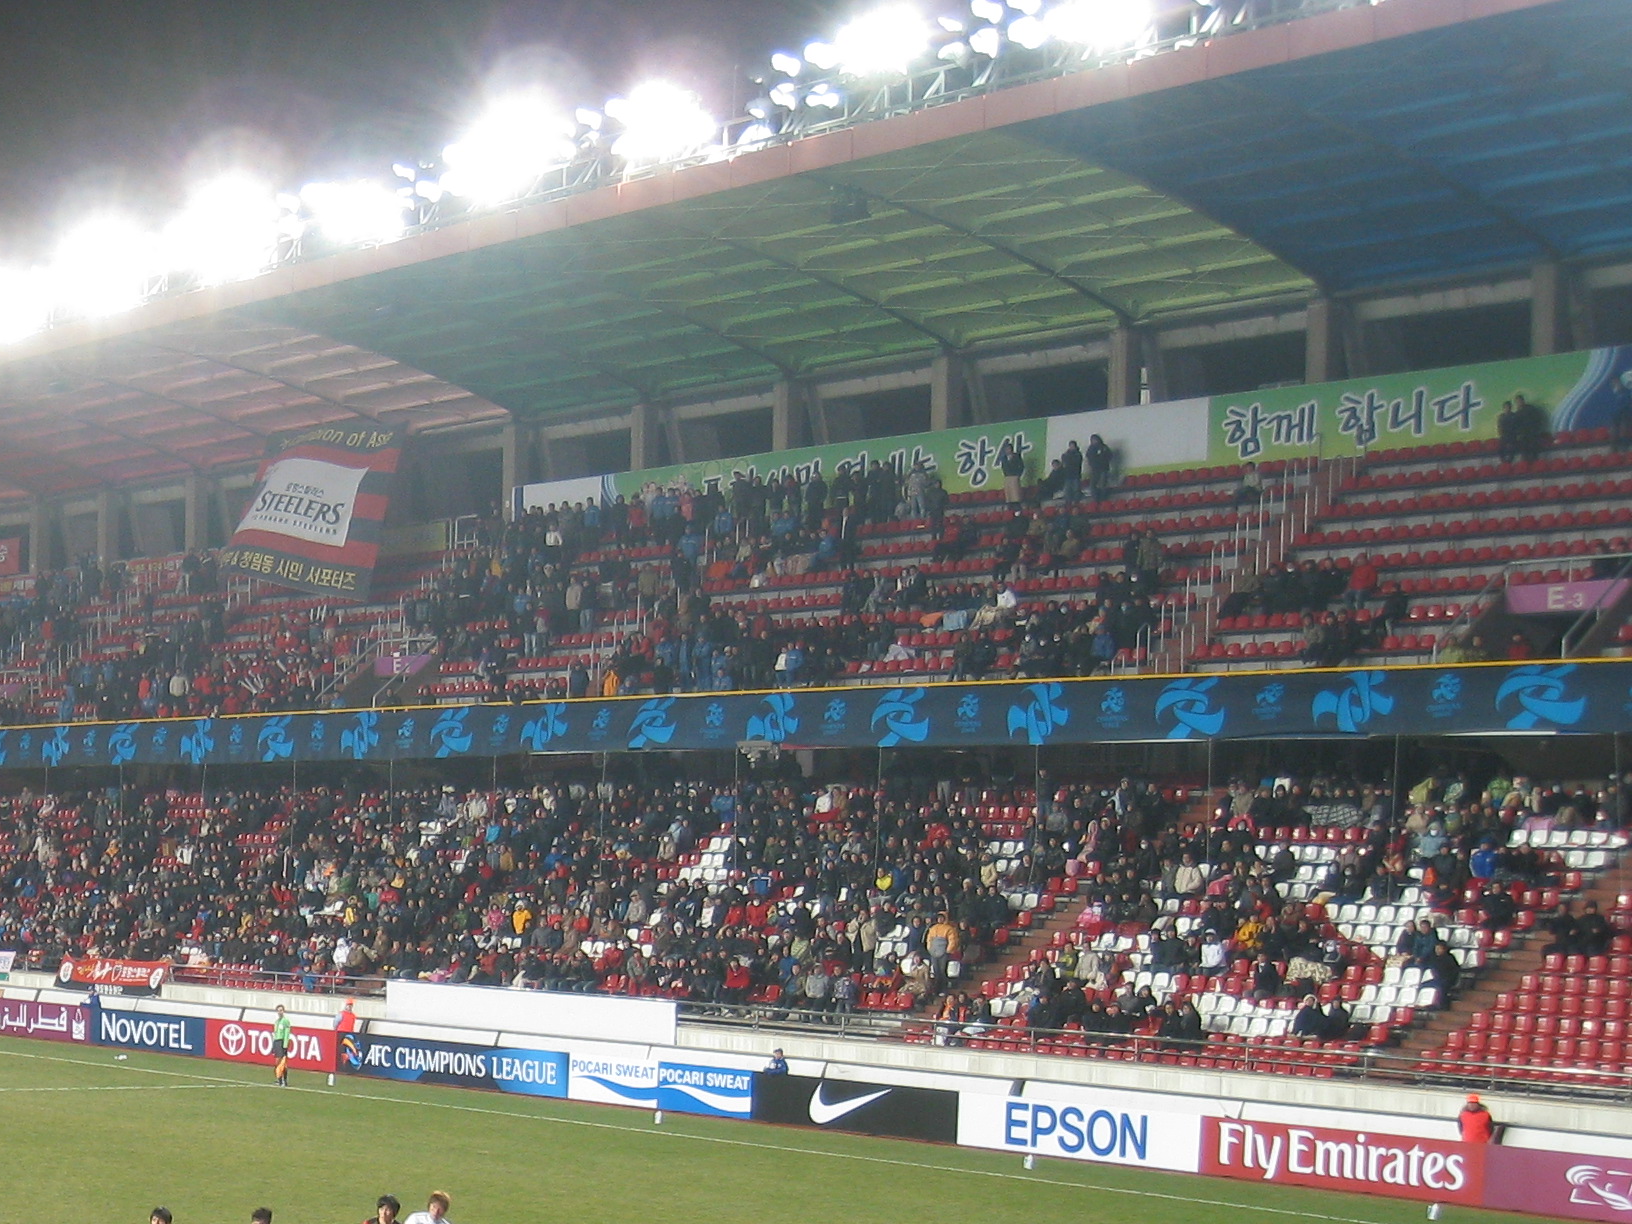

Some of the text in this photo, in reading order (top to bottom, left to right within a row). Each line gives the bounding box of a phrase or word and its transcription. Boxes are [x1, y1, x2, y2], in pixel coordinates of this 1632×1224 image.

[1224, 400, 1318, 458] 함께
[1335, 379, 1483, 448] 합니다
[255, 489, 346, 526] STEELERS
[239, 550, 275, 574] 청림동
[275, 558, 304, 582] 시민
[304, 566, 357, 591] 서포터즈
[1547, 585, 1584, 610] E-3
[27, 1005, 68, 1034] قطر
[100, 1011, 194, 1051] NOVOTEL
[247, 1029, 322, 1062] TOOTA
[364, 1044, 558, 1086] AFC CHAMPIONS LEAGUE
[571, 1058, 656, 1081] POCARI SWEAT
[659, 1067, 751, 1091] POCARI SWEAT
[1004, 1099, 1149, 1160] EPSON
[1217, 1121, 1466, 1192] Fly Emirates
